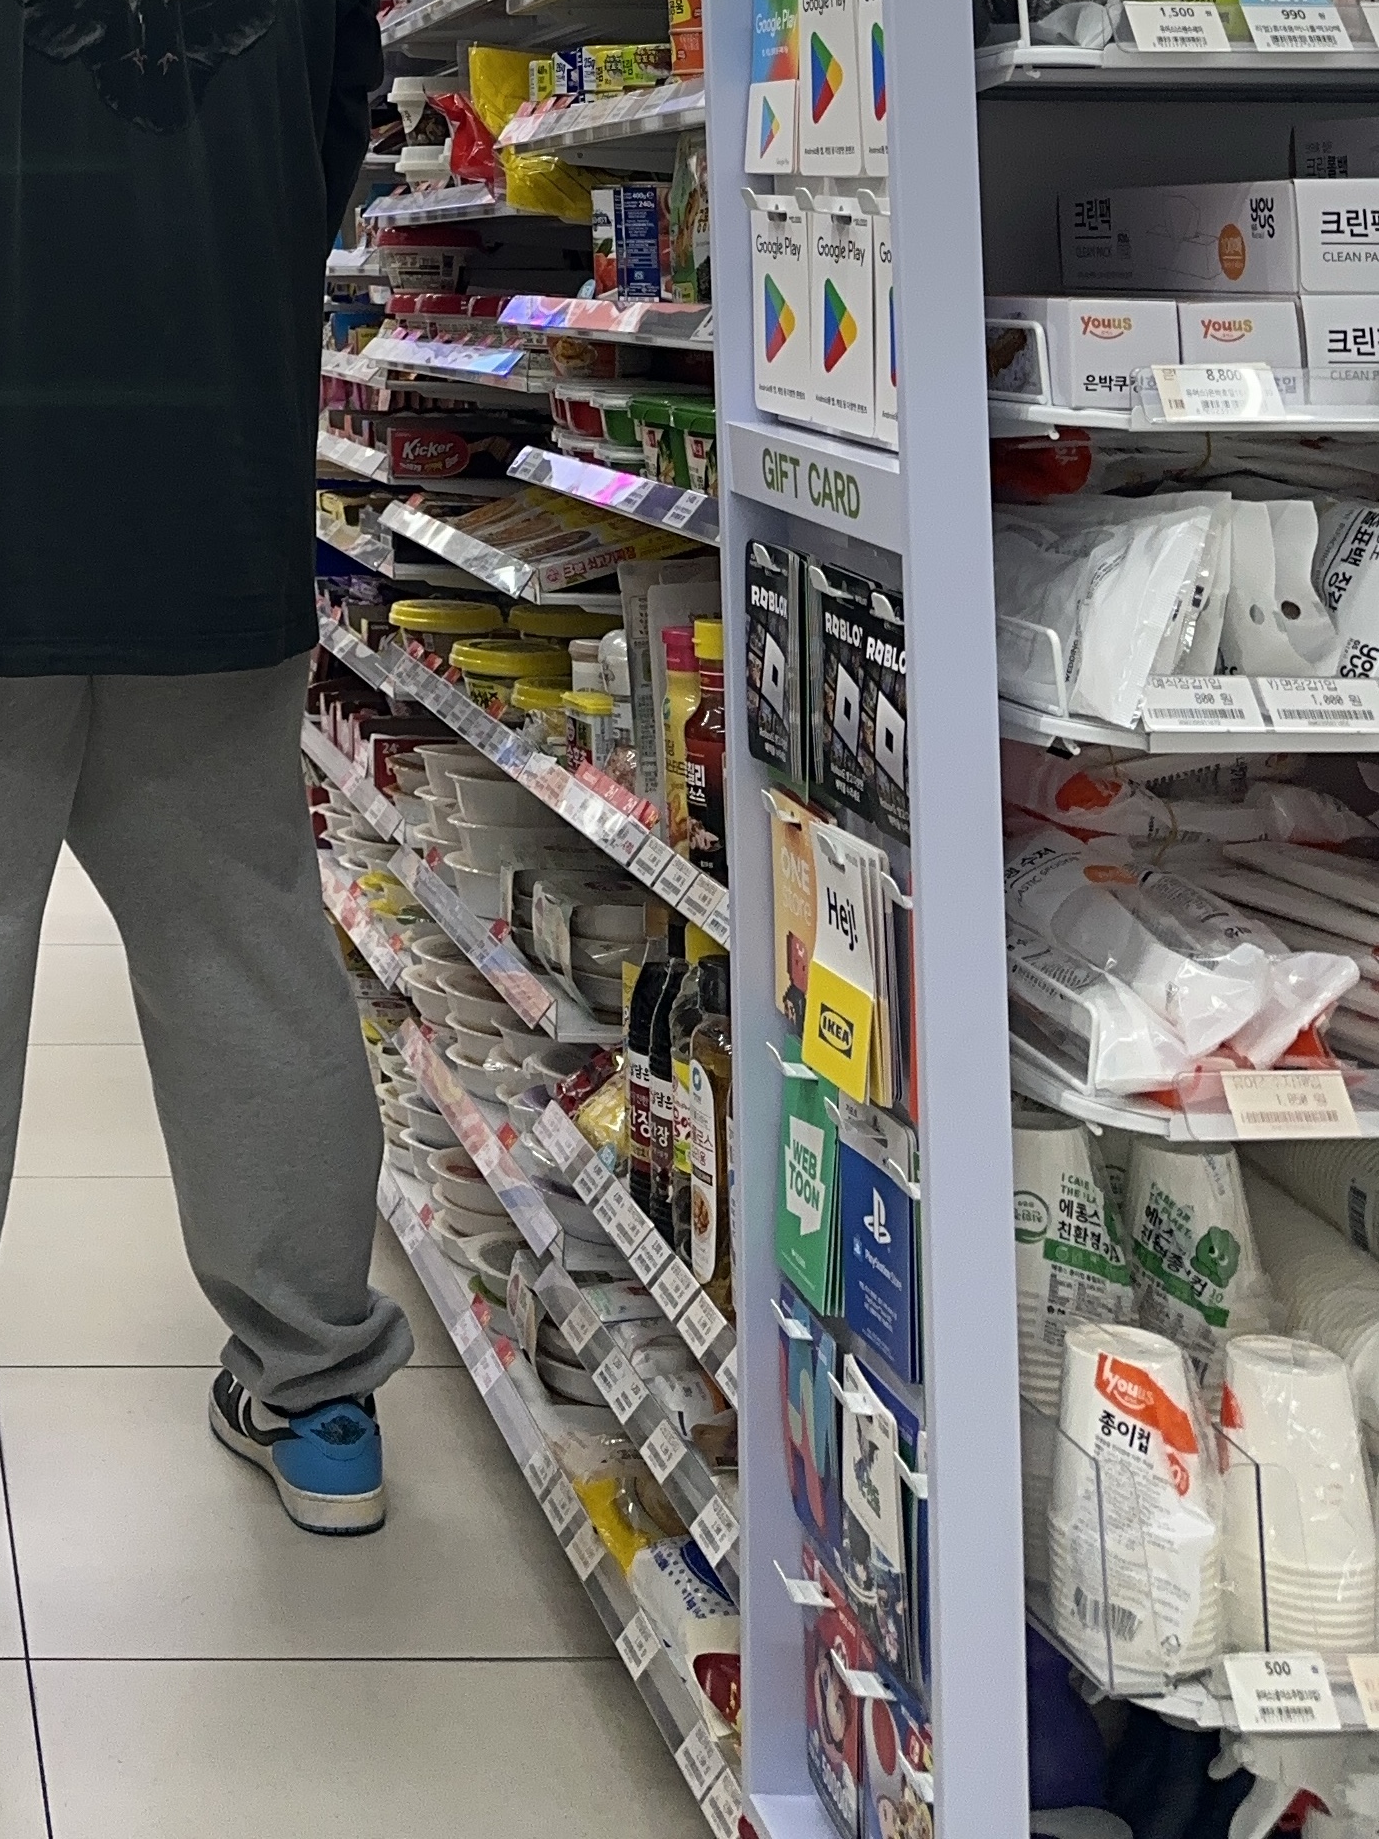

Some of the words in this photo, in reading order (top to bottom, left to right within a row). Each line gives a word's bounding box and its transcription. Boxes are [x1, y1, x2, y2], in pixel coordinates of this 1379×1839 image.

[756, 10, 781, 38] Google
[782, 9, 798, 32] Play
[1160, 7, 1195, 19] 1,500
[1281, 10, 1306, 20] 990
[1250, 197, 1274, 224] you
[755, 233, 784, 260] Google
[784, 236, 802, 262] Play
[817, 235, 846, 264] Google
[847, 239, 866, 267] Play
[1322, 251, 1362, 263] CLEAN
[1080, 315, 1133, 337] youus
[1200, 317, 1254, 339] youus
[1206, 367, 1242, 381] 8,800
[401, 437, 454, 460] Kicker
[762, 447, 800, 499] GIFT
[808, 462, 861, 520] CARD
[865, 636, 906, 675] ROBLO
[1219, 693, 1234, 706] 원
[1349, 695, 1362, 708] 원
[781, 846, 810, 897] ONE
[782, 886, 812, 927] store
[826, 886, 859, 952] Hej!
[822, 1015, 851, 1047] IKEA
[792, 1137, 818, 1180] WEB
[788, 1163, 821, 1212] TOON
[1098, 1409, 1152, 1456] 종이컵
[1265, 1660, 1291, 1677] 500
